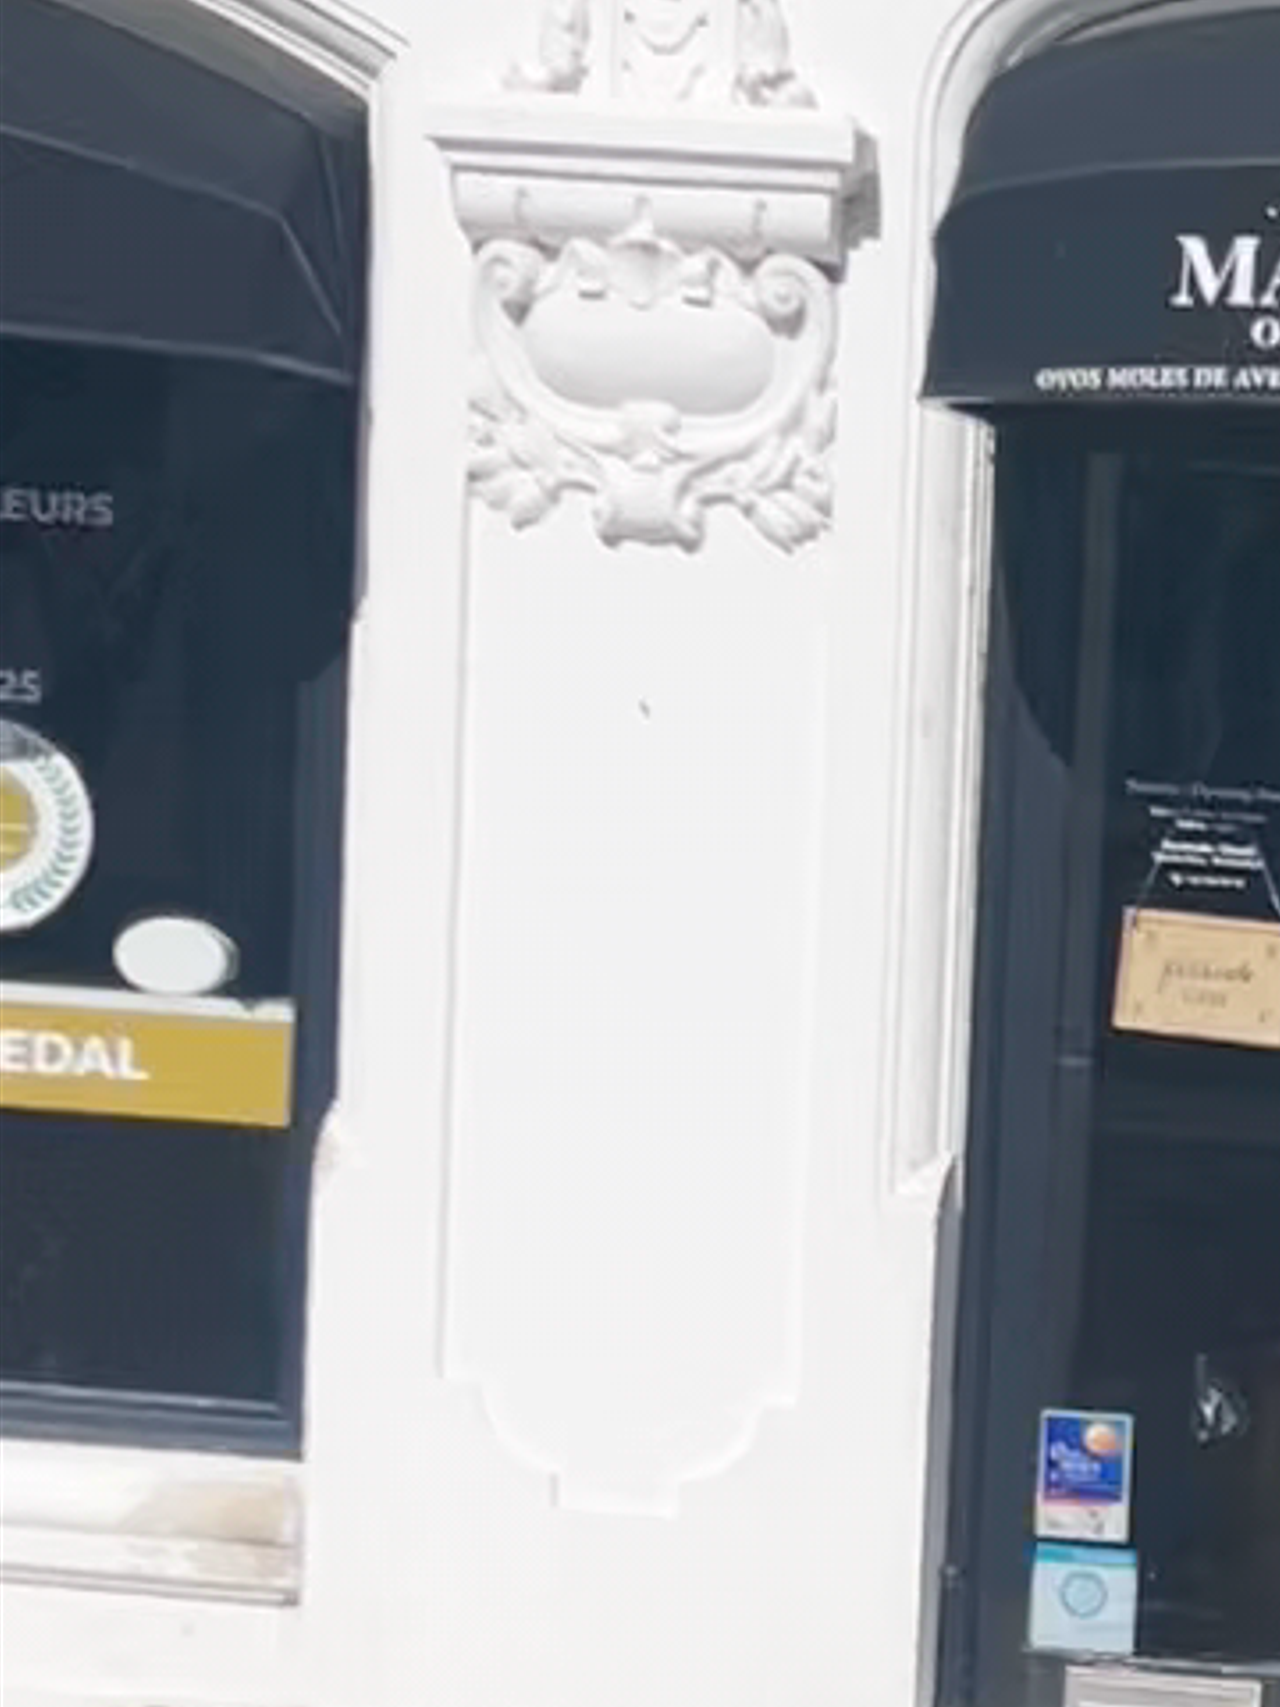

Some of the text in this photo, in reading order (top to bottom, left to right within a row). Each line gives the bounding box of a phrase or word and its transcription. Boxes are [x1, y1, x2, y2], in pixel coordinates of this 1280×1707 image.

[1035, 367, 1101, 391] OVOS
[1106, 366, 1190, 391] MOLES
[1193, 366, 1228, 391] DE
[0, 1028, 152, 1081] EDAL
